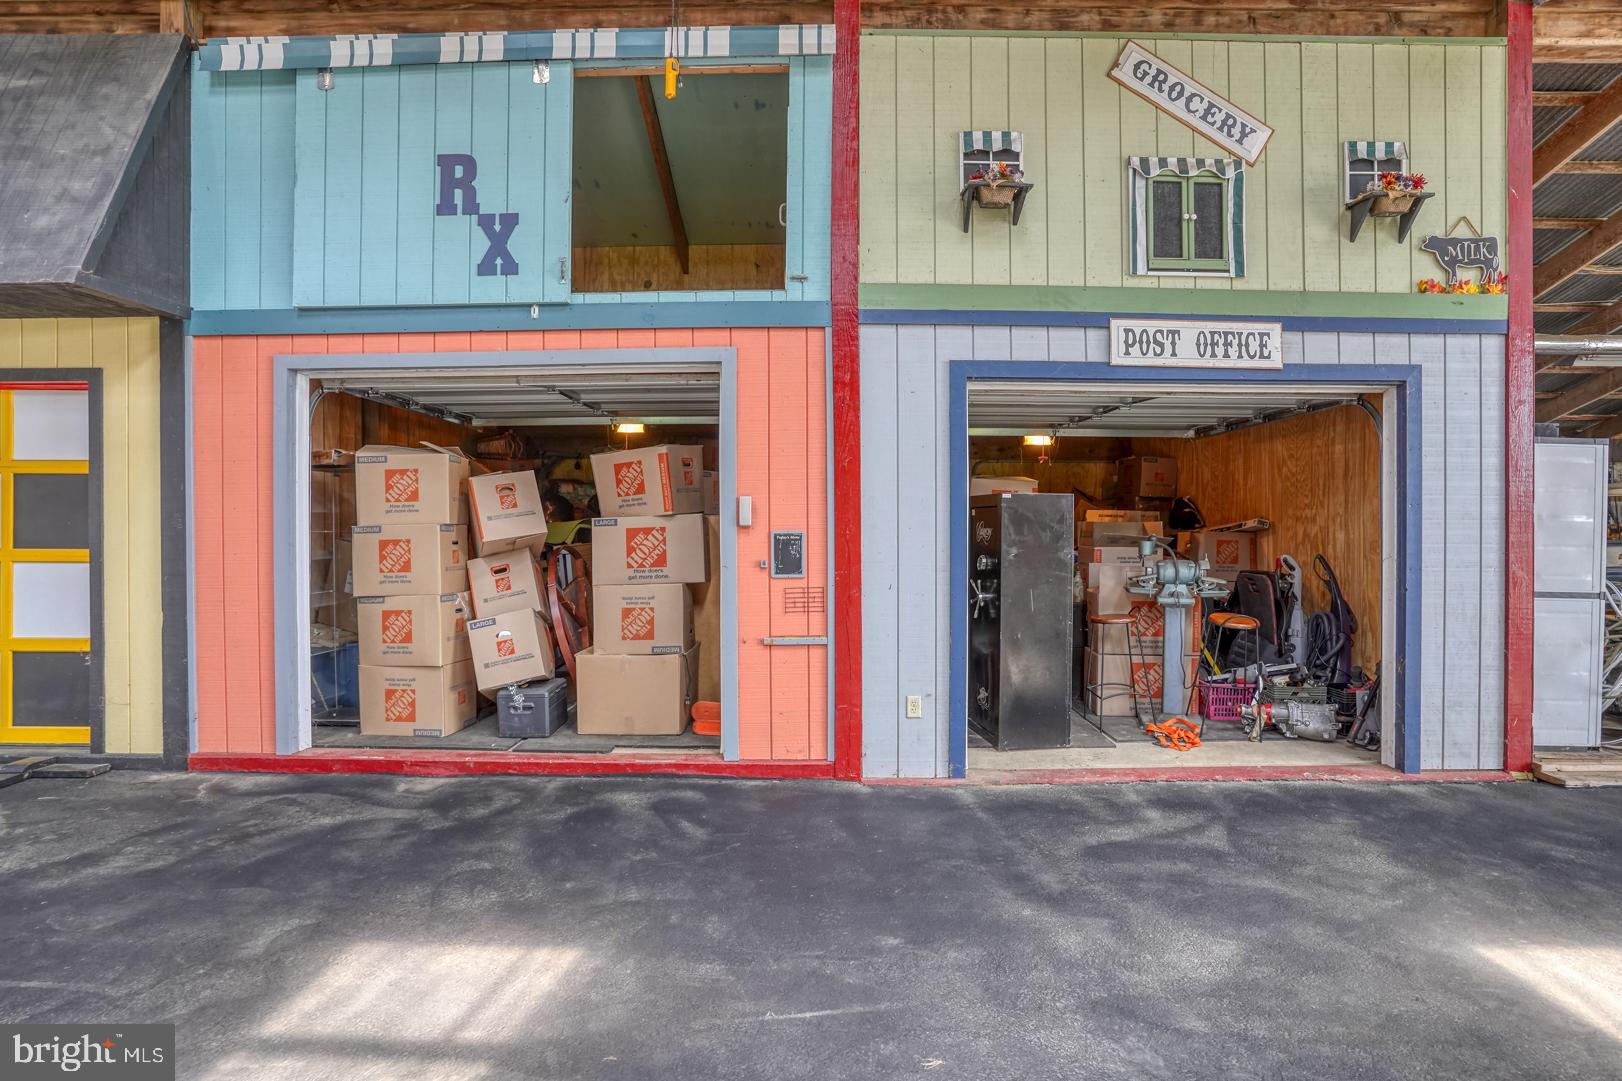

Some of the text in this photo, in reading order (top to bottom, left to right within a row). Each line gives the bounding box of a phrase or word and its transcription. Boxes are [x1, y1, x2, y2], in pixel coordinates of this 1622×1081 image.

[1132, 59, 1257, 145] GROCERY
[1444, 241, 1494, 262] MILK
[1123, 328, 1272, 360] POST OFFICE
[385, 468, 419, 502] HOME
[399, 482, 419, 502] DEPOT
[617, 460, 643, 497] HOME
[380, 538, 413, 573] HOME
[627, 527, 666, 568] HOME
[629, 532, 648, 548] THE
[642, 541, 666, 568] DEPOT
[383, 609, 414, 643] HOME
[393, 622, 413, 644] DEPOT
[472, 620, 494, 629] LARGE
[622, 607, 656, 640] HOME
[384, 689, 417, 722] HOME
